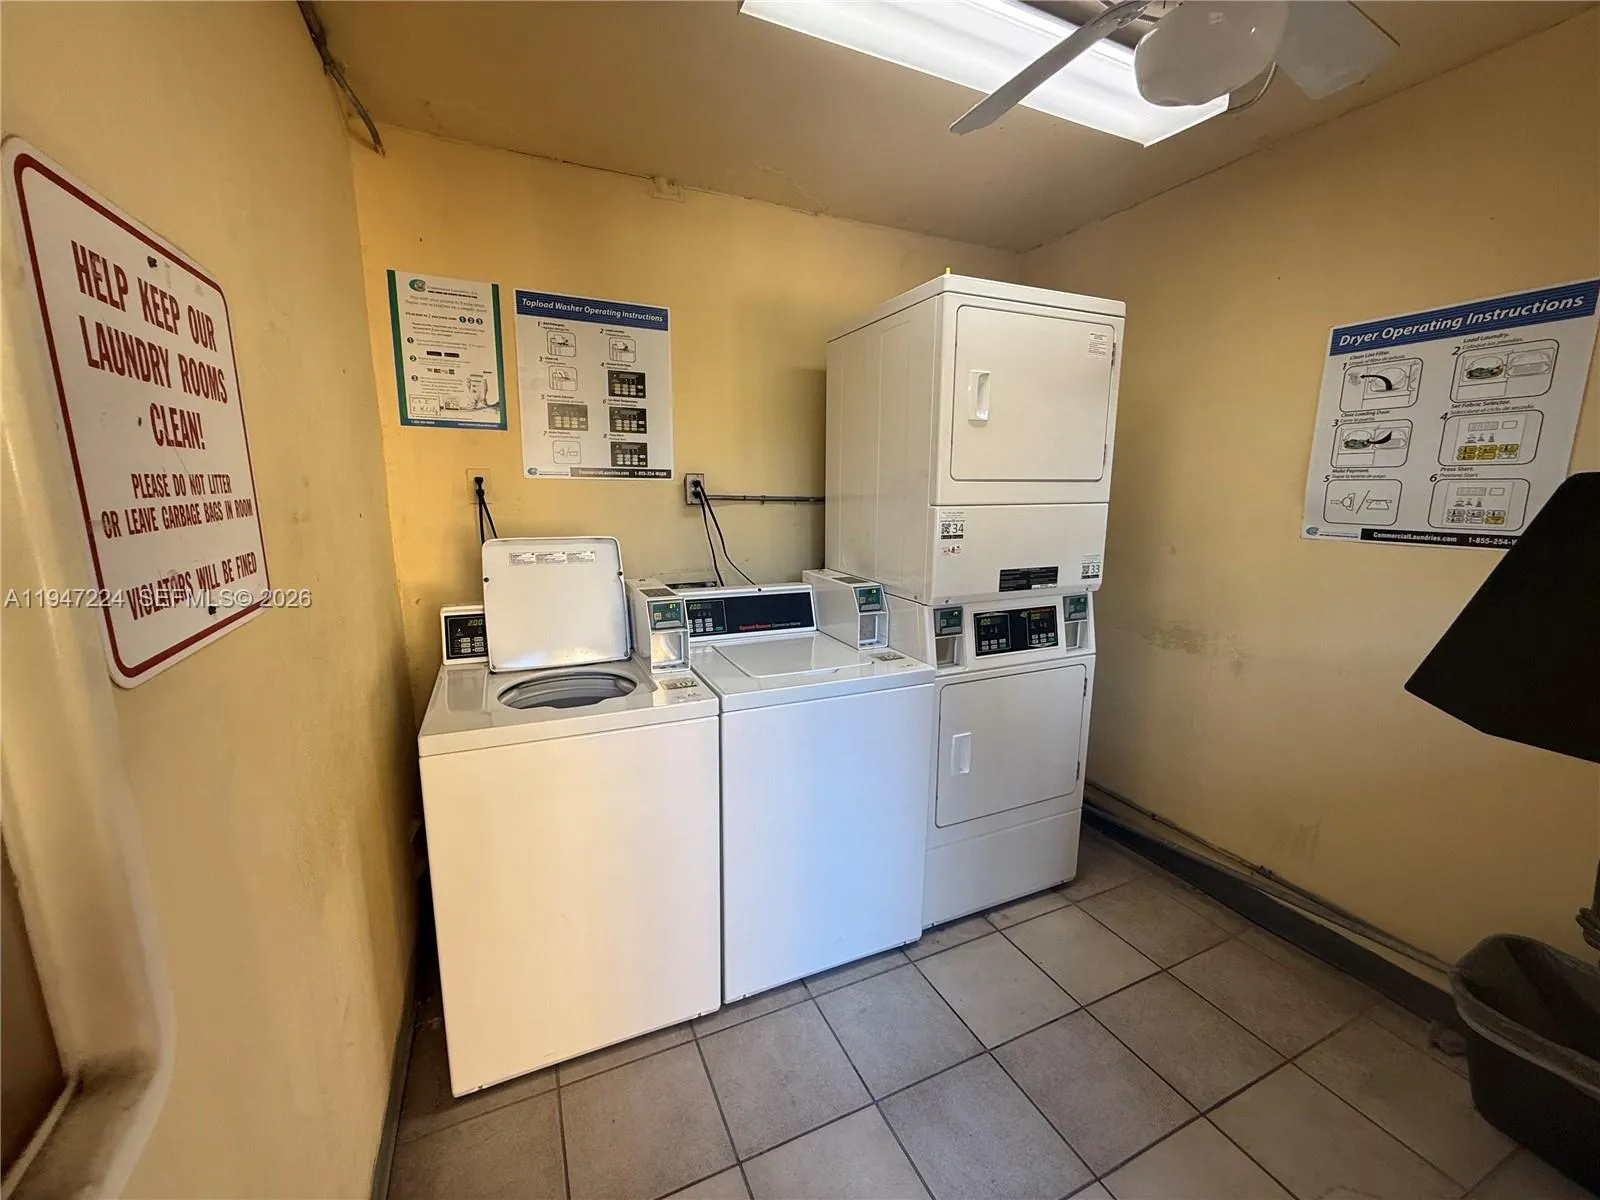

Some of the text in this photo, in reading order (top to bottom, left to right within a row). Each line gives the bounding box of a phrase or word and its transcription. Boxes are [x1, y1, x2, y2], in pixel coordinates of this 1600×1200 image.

[71, 240, 217, 352] HELP KEEP OUR
[522, 298, 662, 322] Topload Washer Operating Instructions
[1339, 295, 1584, 346] Dryer Operating Instructions
[79, 315, 228, 404] LAUNDRY ROOMS
[1452, 346, 1460, 356] 2
[1343, 362, 1347, 370] 1
[150, 402, 206, 450] CLEAN!
[1332, 419, 1339, 427] 3
[1440, 412, 1448, 420] 4
[131, 473, 232, 499] PLEASE DO NOT LITTER
[1430, 473, 1438, 482] 6
[101, 498, 253, 539] OR LEAVE GARBAGE BAGS IN ROOM
[952, 523, 963, 533] 34
[1091, 565, 1100, 574] 33
[126, 552, 258, 620] VIOLATORS WILL BE FINED
